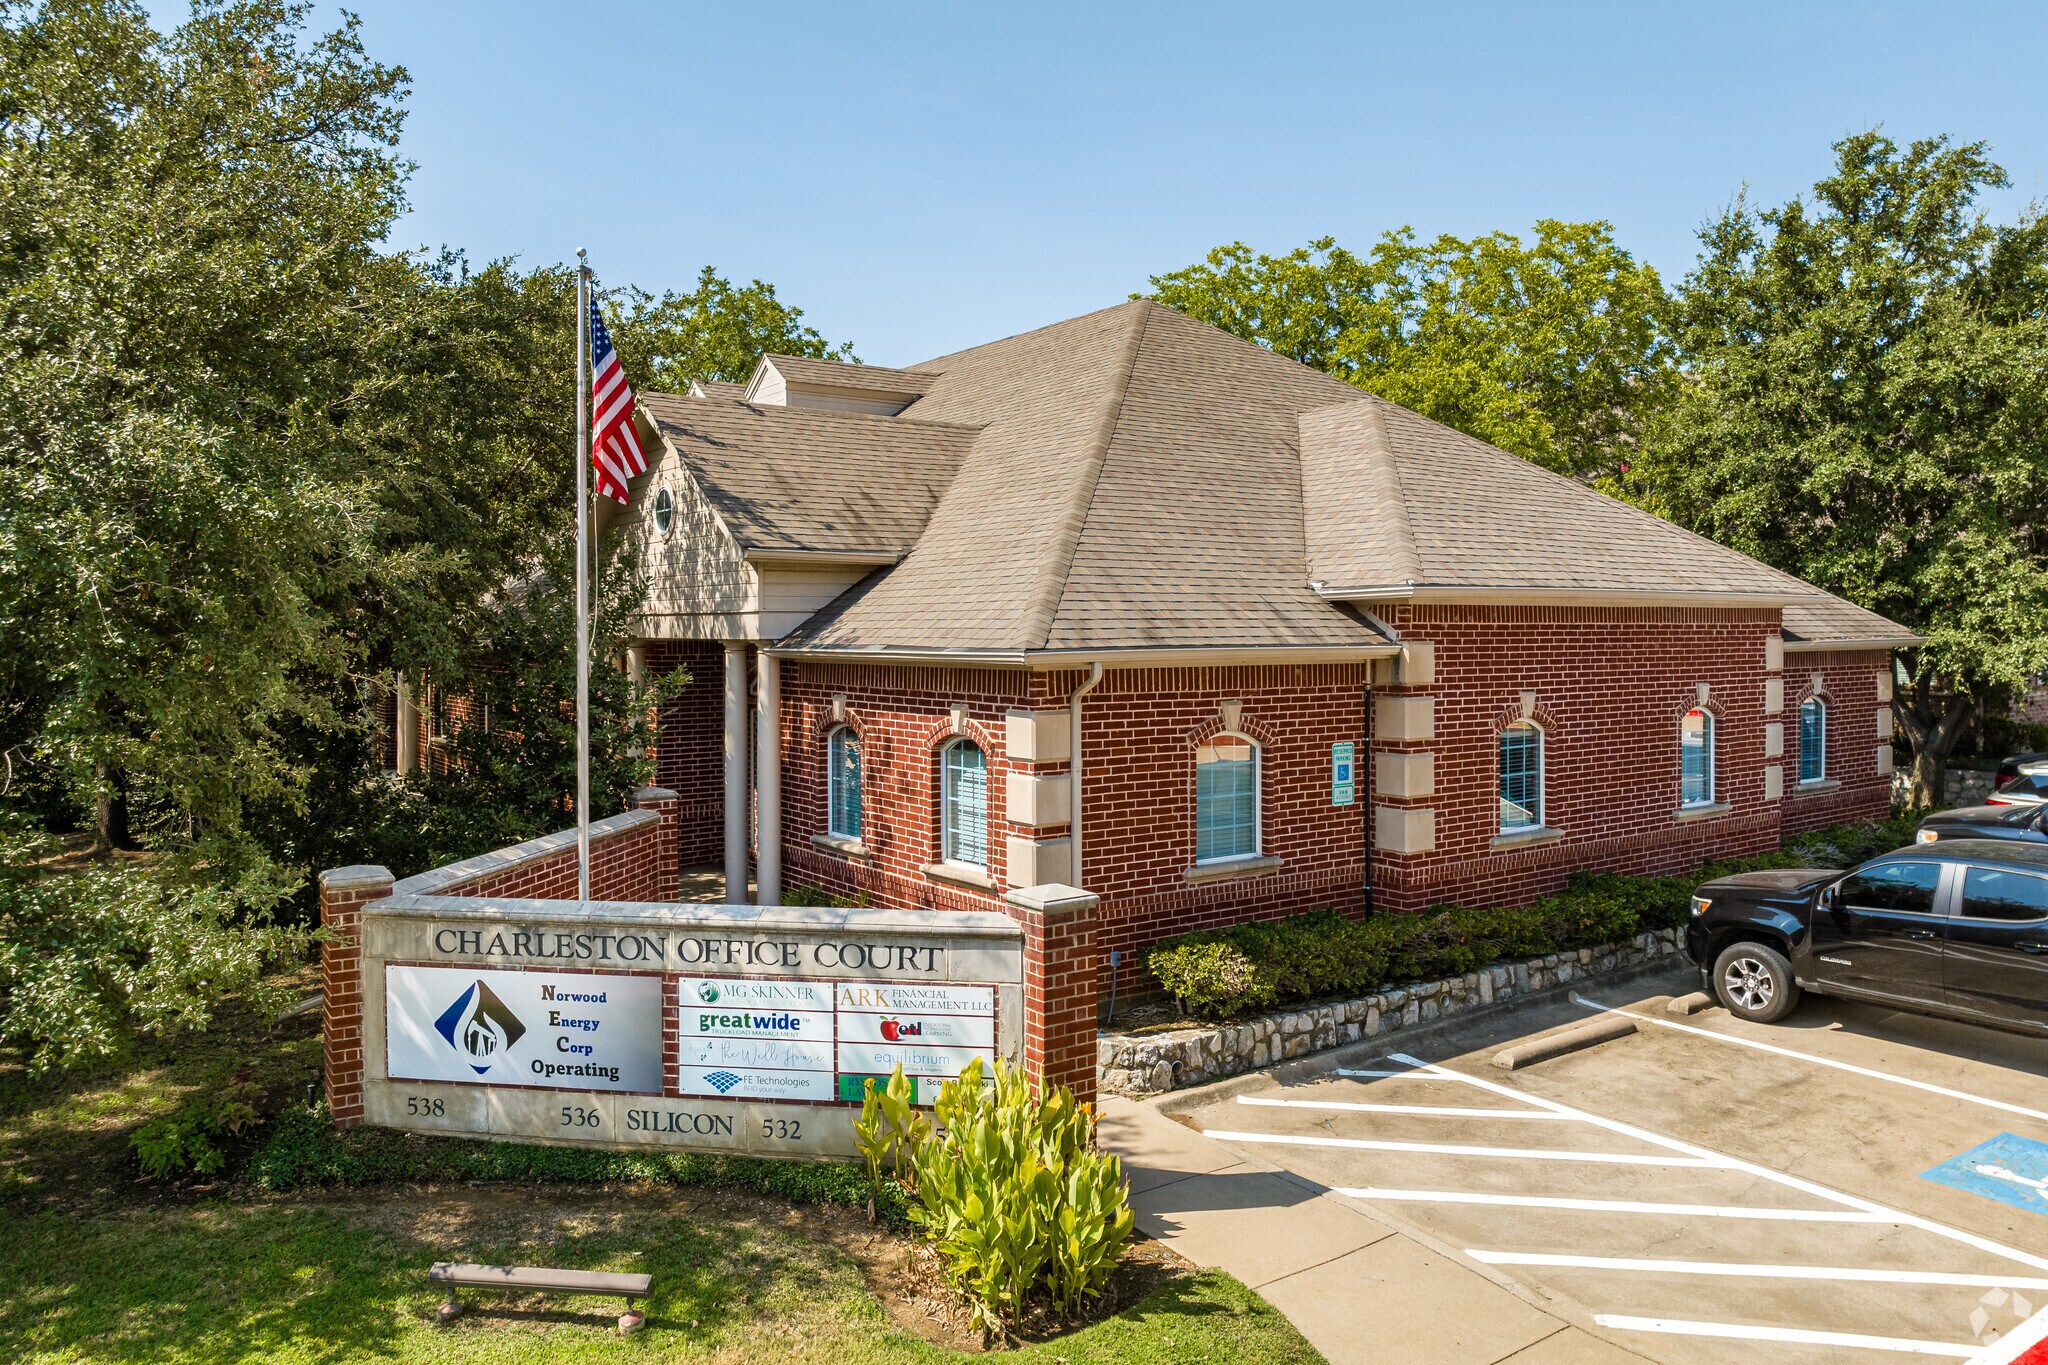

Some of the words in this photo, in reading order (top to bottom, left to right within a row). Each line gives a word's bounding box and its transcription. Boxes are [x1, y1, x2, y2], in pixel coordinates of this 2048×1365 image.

[435, 929, 667, 962] CHARLESTON
[677, 937, 800, 967] OFFICE
[814, 943, 945, 972] COURT
[1820, 956, 1852, 966] COLORADO
[541, 985, 607, 1003] Norwood
[723, 984, 747, 997] MG
[751, 985, 814, 1000] SKINNER
[840, 988, 891, 1008] ARK
[892, 989, 949, 999] FINANCIAL
[892, 1000, 968, 1010] MANAGEMENT
[972, 1002, 992, 1011] LLC
[548, 1010, 600, 1031] Energy
[700, 1013, 800, 1032] greatwide
[898, 1022, 922, 1036] etl
[556, 1036, 593, 1056] Corp
[741, 1042, 779, 1066] Well
[780, 1043, 825, 1067] House
[874, 1049, 950, 1069] equilibrium
[531, 1059, 620, 1082] Operating
[743, 1075, 753, 1084] FE
[756, 1076, 810, 1089] Technologies
[407, 1097, 445, 1117] 538
[561, 1107, 601, 1128] 536
[627, 1109, 734, 1136] SILICON
[762, 1118, 803, 1140] 532
